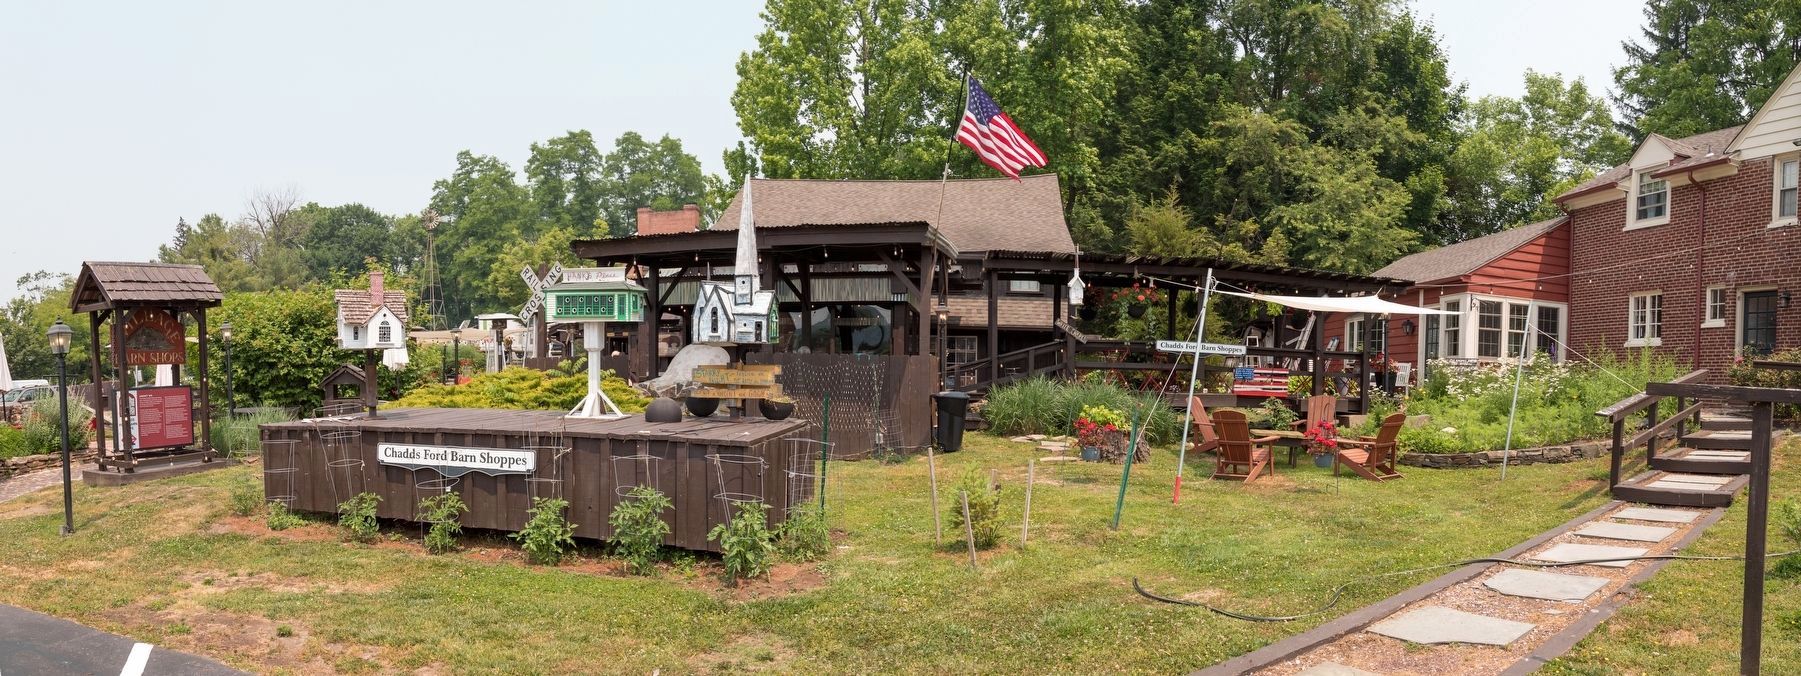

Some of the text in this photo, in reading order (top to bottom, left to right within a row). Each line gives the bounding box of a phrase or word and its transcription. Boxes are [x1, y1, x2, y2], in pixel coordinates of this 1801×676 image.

[1160, 341, 1184, 350] Chadds
[1201, 344, 1216, 352] Barn
[1216, 345, 1243, 354] Shoppes
[150, 351, 184, 363] SHOPS
[384, 446, 528, 469] Chadds Ford Barn Shoppes
